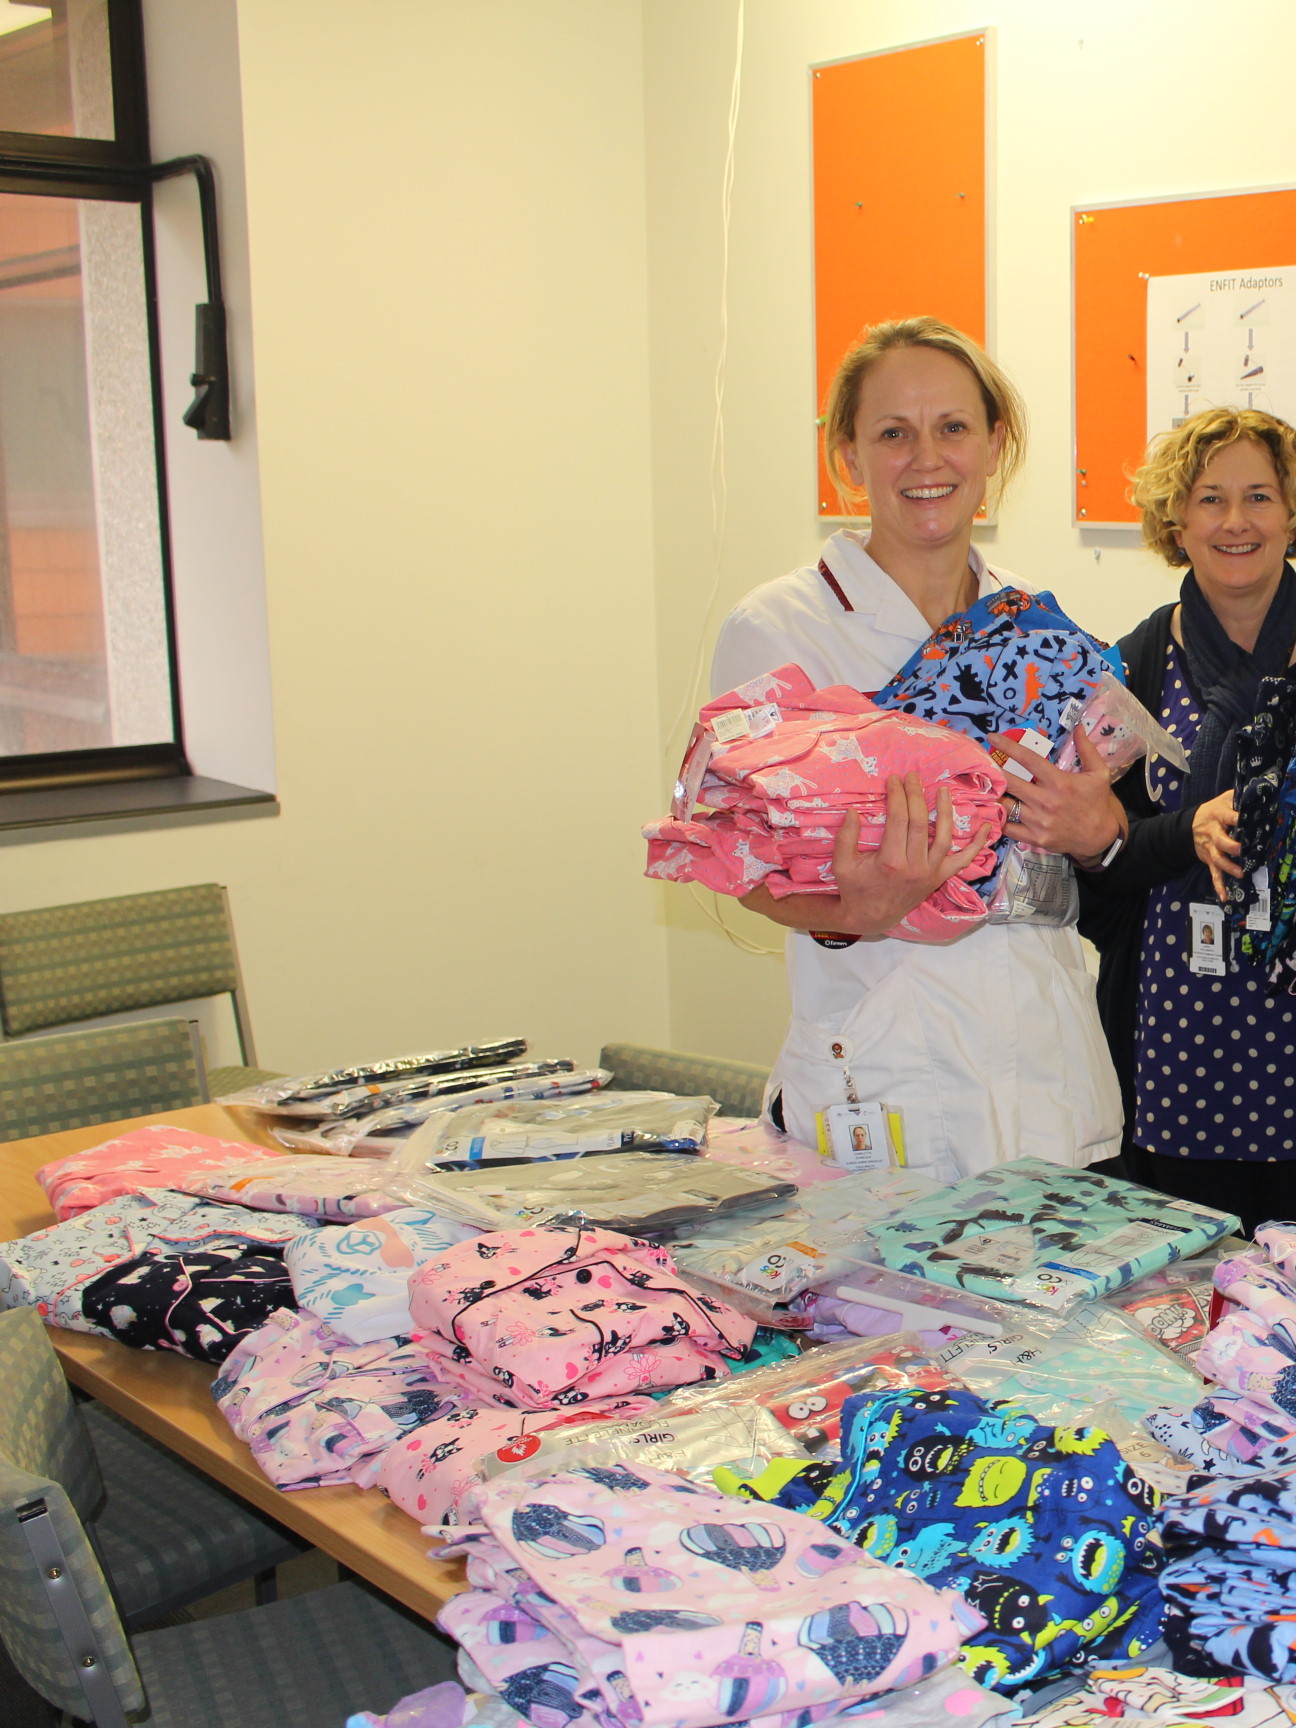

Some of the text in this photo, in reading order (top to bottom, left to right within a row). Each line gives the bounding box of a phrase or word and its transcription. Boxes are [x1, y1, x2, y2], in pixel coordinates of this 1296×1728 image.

[1210, 276, 1283, 292] ENFIT Adaptors
[1120, 1441, 1149, 1455] SIZE
